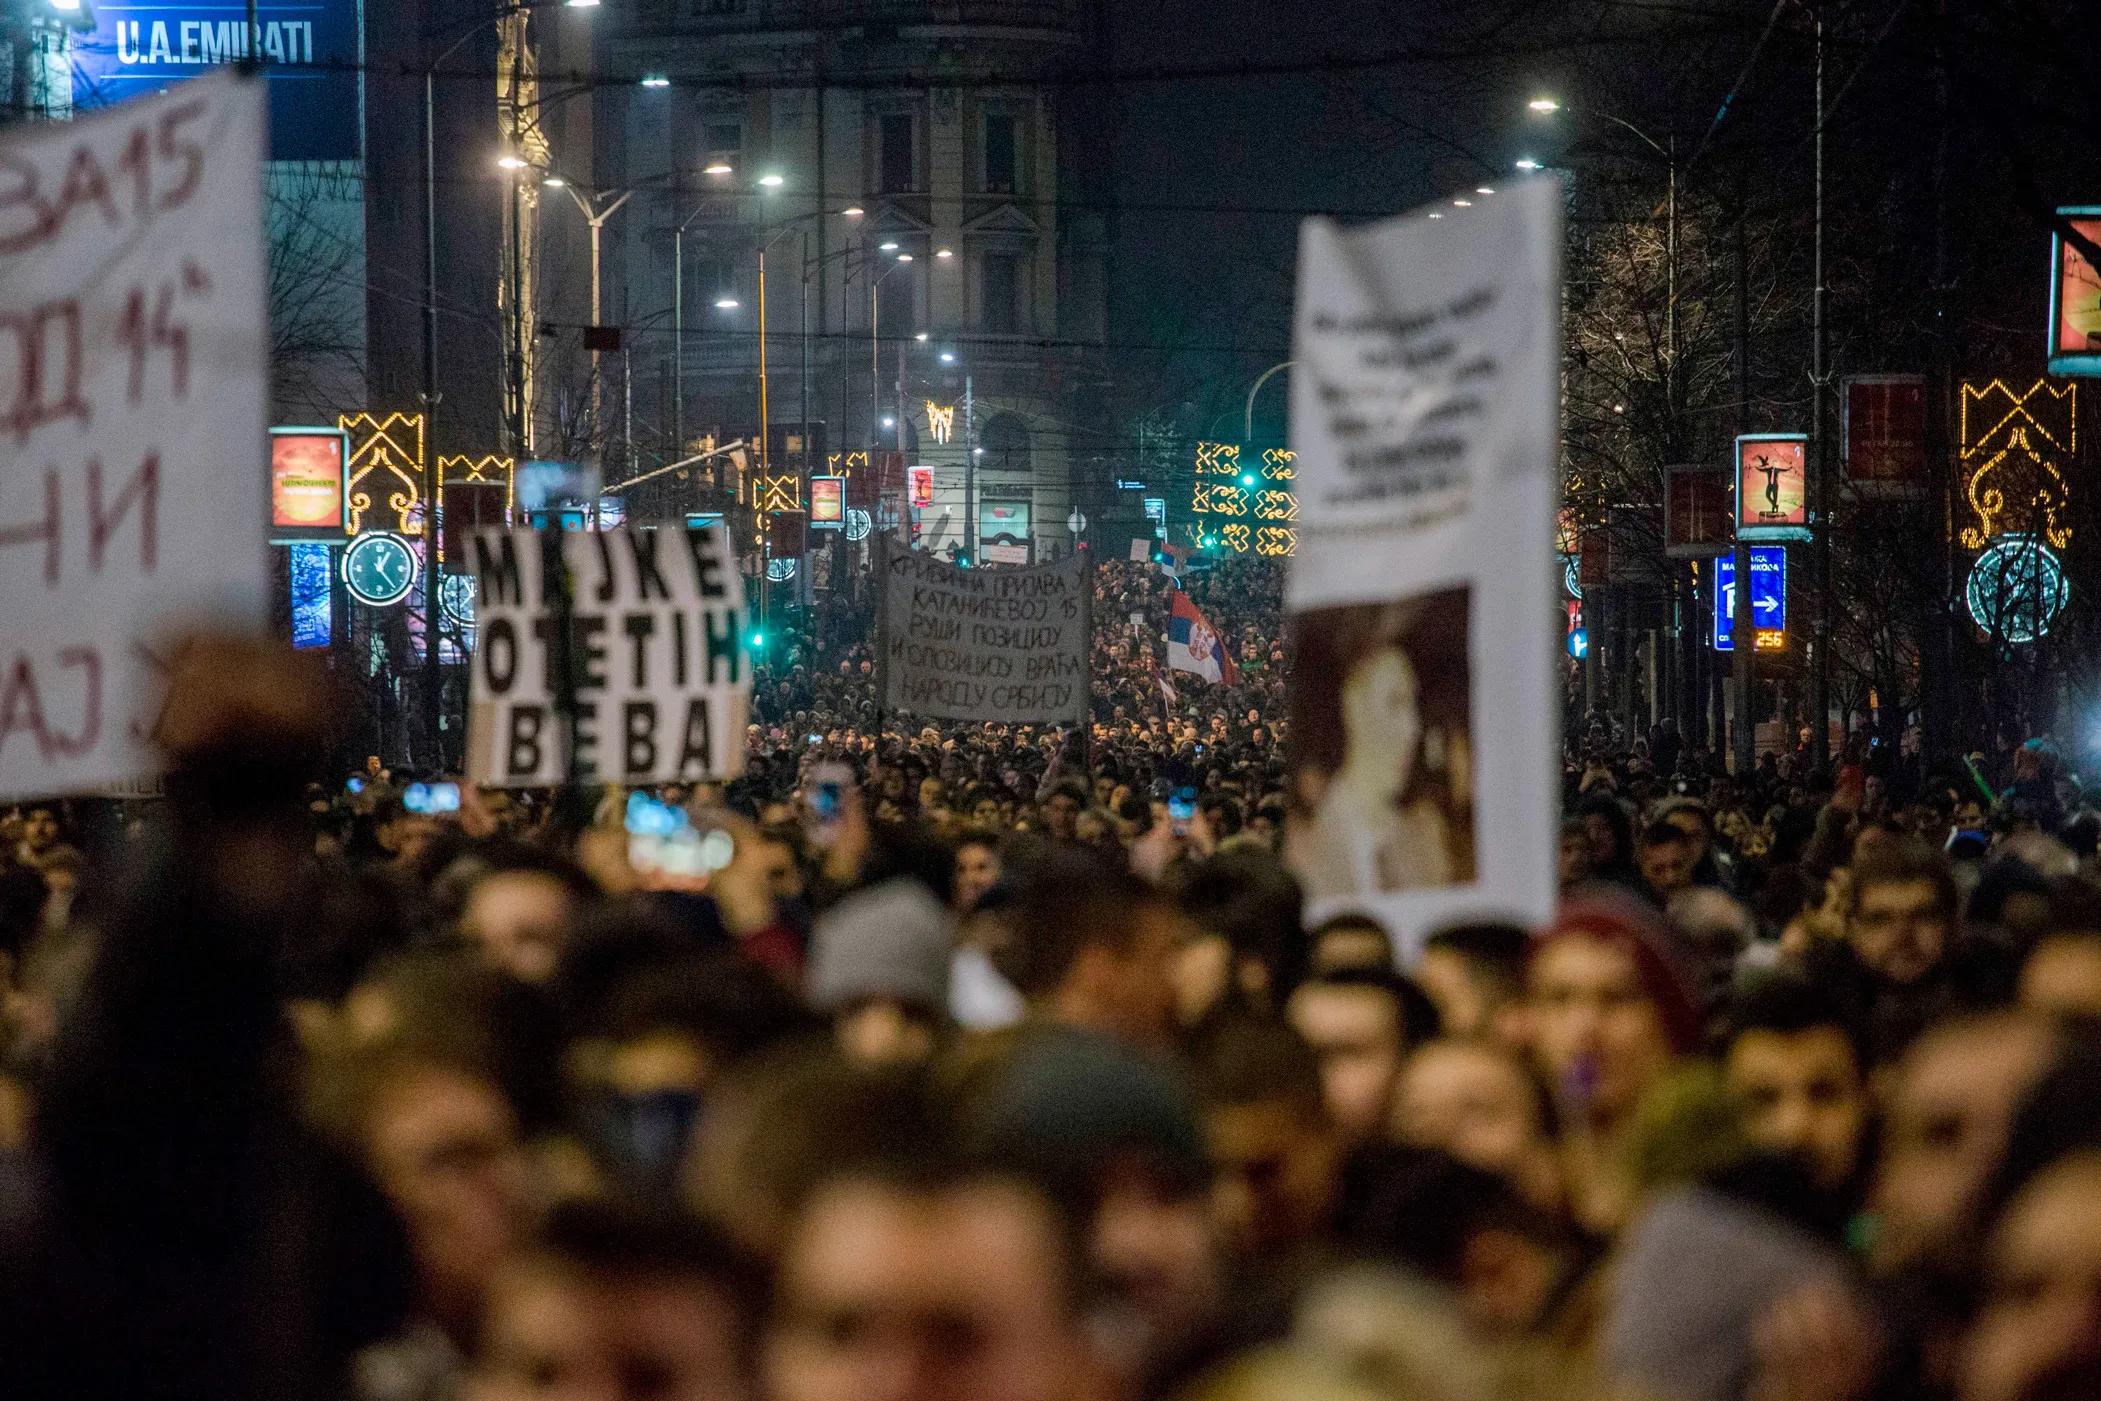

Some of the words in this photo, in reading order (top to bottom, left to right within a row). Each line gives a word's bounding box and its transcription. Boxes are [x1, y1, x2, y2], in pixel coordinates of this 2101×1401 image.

[475, 529, 725, 607] MJKE
[1059, 596, 1079, 620] 15
[1757, 631, 1783, 647] 256
